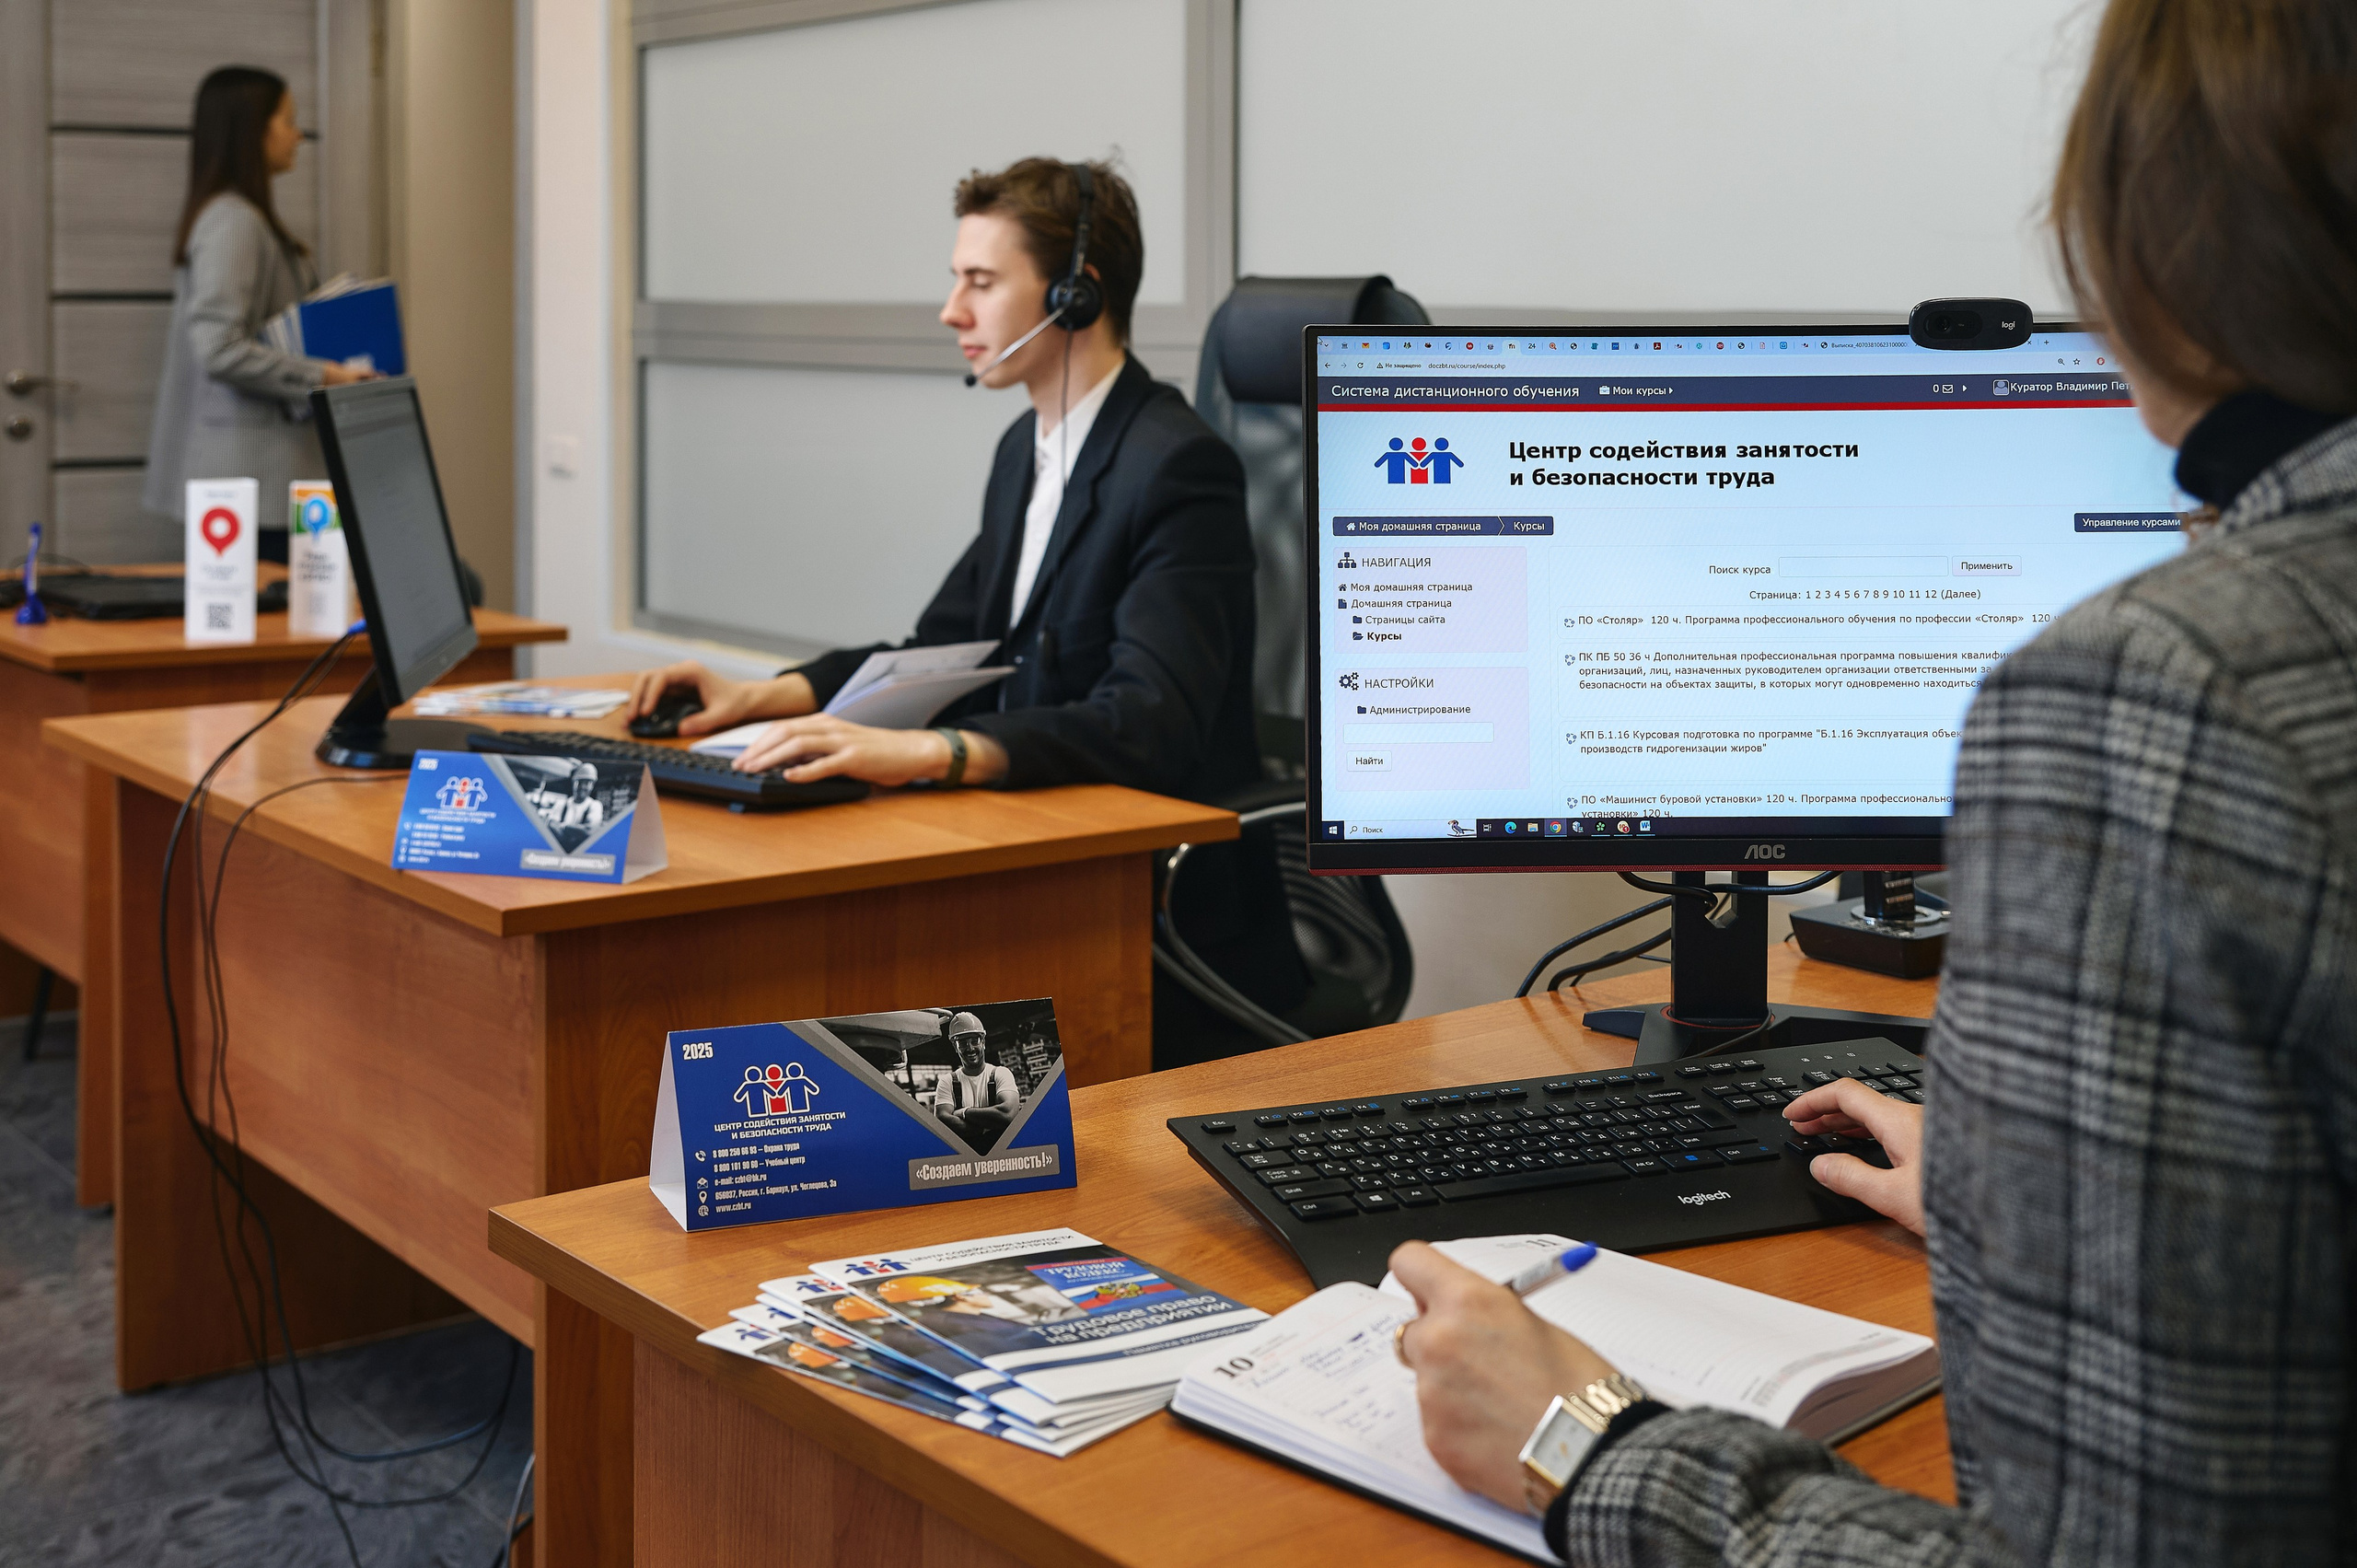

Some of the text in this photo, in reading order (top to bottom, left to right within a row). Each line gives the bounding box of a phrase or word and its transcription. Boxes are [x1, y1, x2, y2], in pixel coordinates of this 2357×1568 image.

[2002, 320, 2015, 330] logi
[1428, 362, 1506, 372] doczbt.ru/course/index.php
[1331, 385, 1579, 399] Система дистанционного обучения
[1613, 385, 1666, 397] Мои курсы
[2010, 381, 2052, 393] Куратор
[2056, 380, 2107, 392] Владимир
[1509, 438, 1859, 462] Центр содействия занятости
[1510, 467, 1774, 488] и безопасности труда
[1359, 521, 1481, 532] Моя домашняя страница
[1513, 521, 1545, 532] Курсы
[2082, 517, 2180, 528] Управление курсами
[1362, 557, 1431, 569] НАВИГАЦИЯ
[1961, 561, 2013, 571] Применить
[1709, 565, 1771, 575] Поиск курса
[1350, 583, 1472, 592] Моя домашняя страница
[1749, 590, 1801, 600] Страница:
[1805, 590, 1811, 598] 1
[1815, 590, 1821, 598] 2
[1825, 590, 1830, 598] 3
[1844, 590, 1850, 598] 5
[1853, 590, 1860, 598] 6
[1873, 589, 1879, 598] 8
[1882, 589, 1888, 598] 9
[1893, 589, 1905, 598] 10
[1924, 589, 1937, 598] 12
[1941, 589, 1980, 599] (Далее)
[1351, 598, 1451, 609] Домашняя страница
[1364, 615, 1446, 625] Страницы сайта
[1578, 616, 1593, 624] ПО
[1596, 615, 1643, 625] «Столяр»
[1651, 615, 1668, 623] 120
[1685, 615, 1740, 625] Программа
[1743, 614, 1844, 625] профессионального
[1847, 614, 1896, 624] обучения
[1915, 613, 1970, 624] профессии
[1975, 614, 2024, 624] «Столяр»
[2032, 613, 2050, 622] 120
[1366, 632, 1401, 642] Курсы
[1578, 652, 1593, 660] ПК
[1596, 652, 1609, 660] ПБ
[1613, 652, 1625, 660] 50
[1629, 652, 1641, 660] 36
[1653, 652, 1736, 661] Дополнительная
[1740, 651, 1836, 661] профессиональная
[1840, 653, 1895, 661] программа
[1578, 667, 1646, 676] организаций,
[1649, 668, 1671, 676] лиц,
[1745, 667, 1821, 675] руководителем
[1825, 667, 1889, 675] организации
[1364, 676, 1434, 688] НАСТРОЙКИ
[1579, 679, 1646, 689] безопасности
[1665, 679, 1711, 688] объектах
[1714, 681, 1756, 690] защиты,
[1769, 680, 1811, 690] которых
[1815, 680, 1843, 689] могут
[1846, 680, 1920, 689] одновременно
[1369, 705, 1470, 715] Администрирование
[1580, 730, 1594, 738] КП
[1597, 730, 1630, 738] Б.1.16
[1632, 730, 1679, 740] Курсовая
[1683, 731, 1739, 739] подготовка
[1759, 731, 1812, 739] программе
[1816, 728, 1852, 738] "Б.1.16
[1856, 728, 1928, 739] Эксплуатация
[1580, 743, 1766, 754] производств гидрогенизации жиров"
[1581, 796, 1596, 804] ПО
[1659, 794, 1701, 805] буровой
[1704, 796, 1762, 804] установки»
[1766, 794, 1784, 802] 120
[1801, 794, 1856, 804] Программа
[1744, 844, 1785, 859] AOC
[682, 1042, 714, 1060] 2025
[714, 1111, 846, 1132] ЦЕНТР СОДЕЙСТВИЯ ЗАНЯТОСТИ
[739, 1126, 804, 1139] БЕЗОПАСНОСТИ
[805, 1123, 832, 1132] ТРУДА
[916, 1152, 1052, 1180] «Создаем уверенность!»
[1678, 1190, 1731, 1205] logitech
[1526, 1235, 1560, 1247] 11
[1028, 1295, 1217, 1336] Трудовое право
[1045, 1331, 1079, 1345] на
[1079, 1301, 1233, 1342] предприятии
[1213, 1355, 1255, 1380] 10
